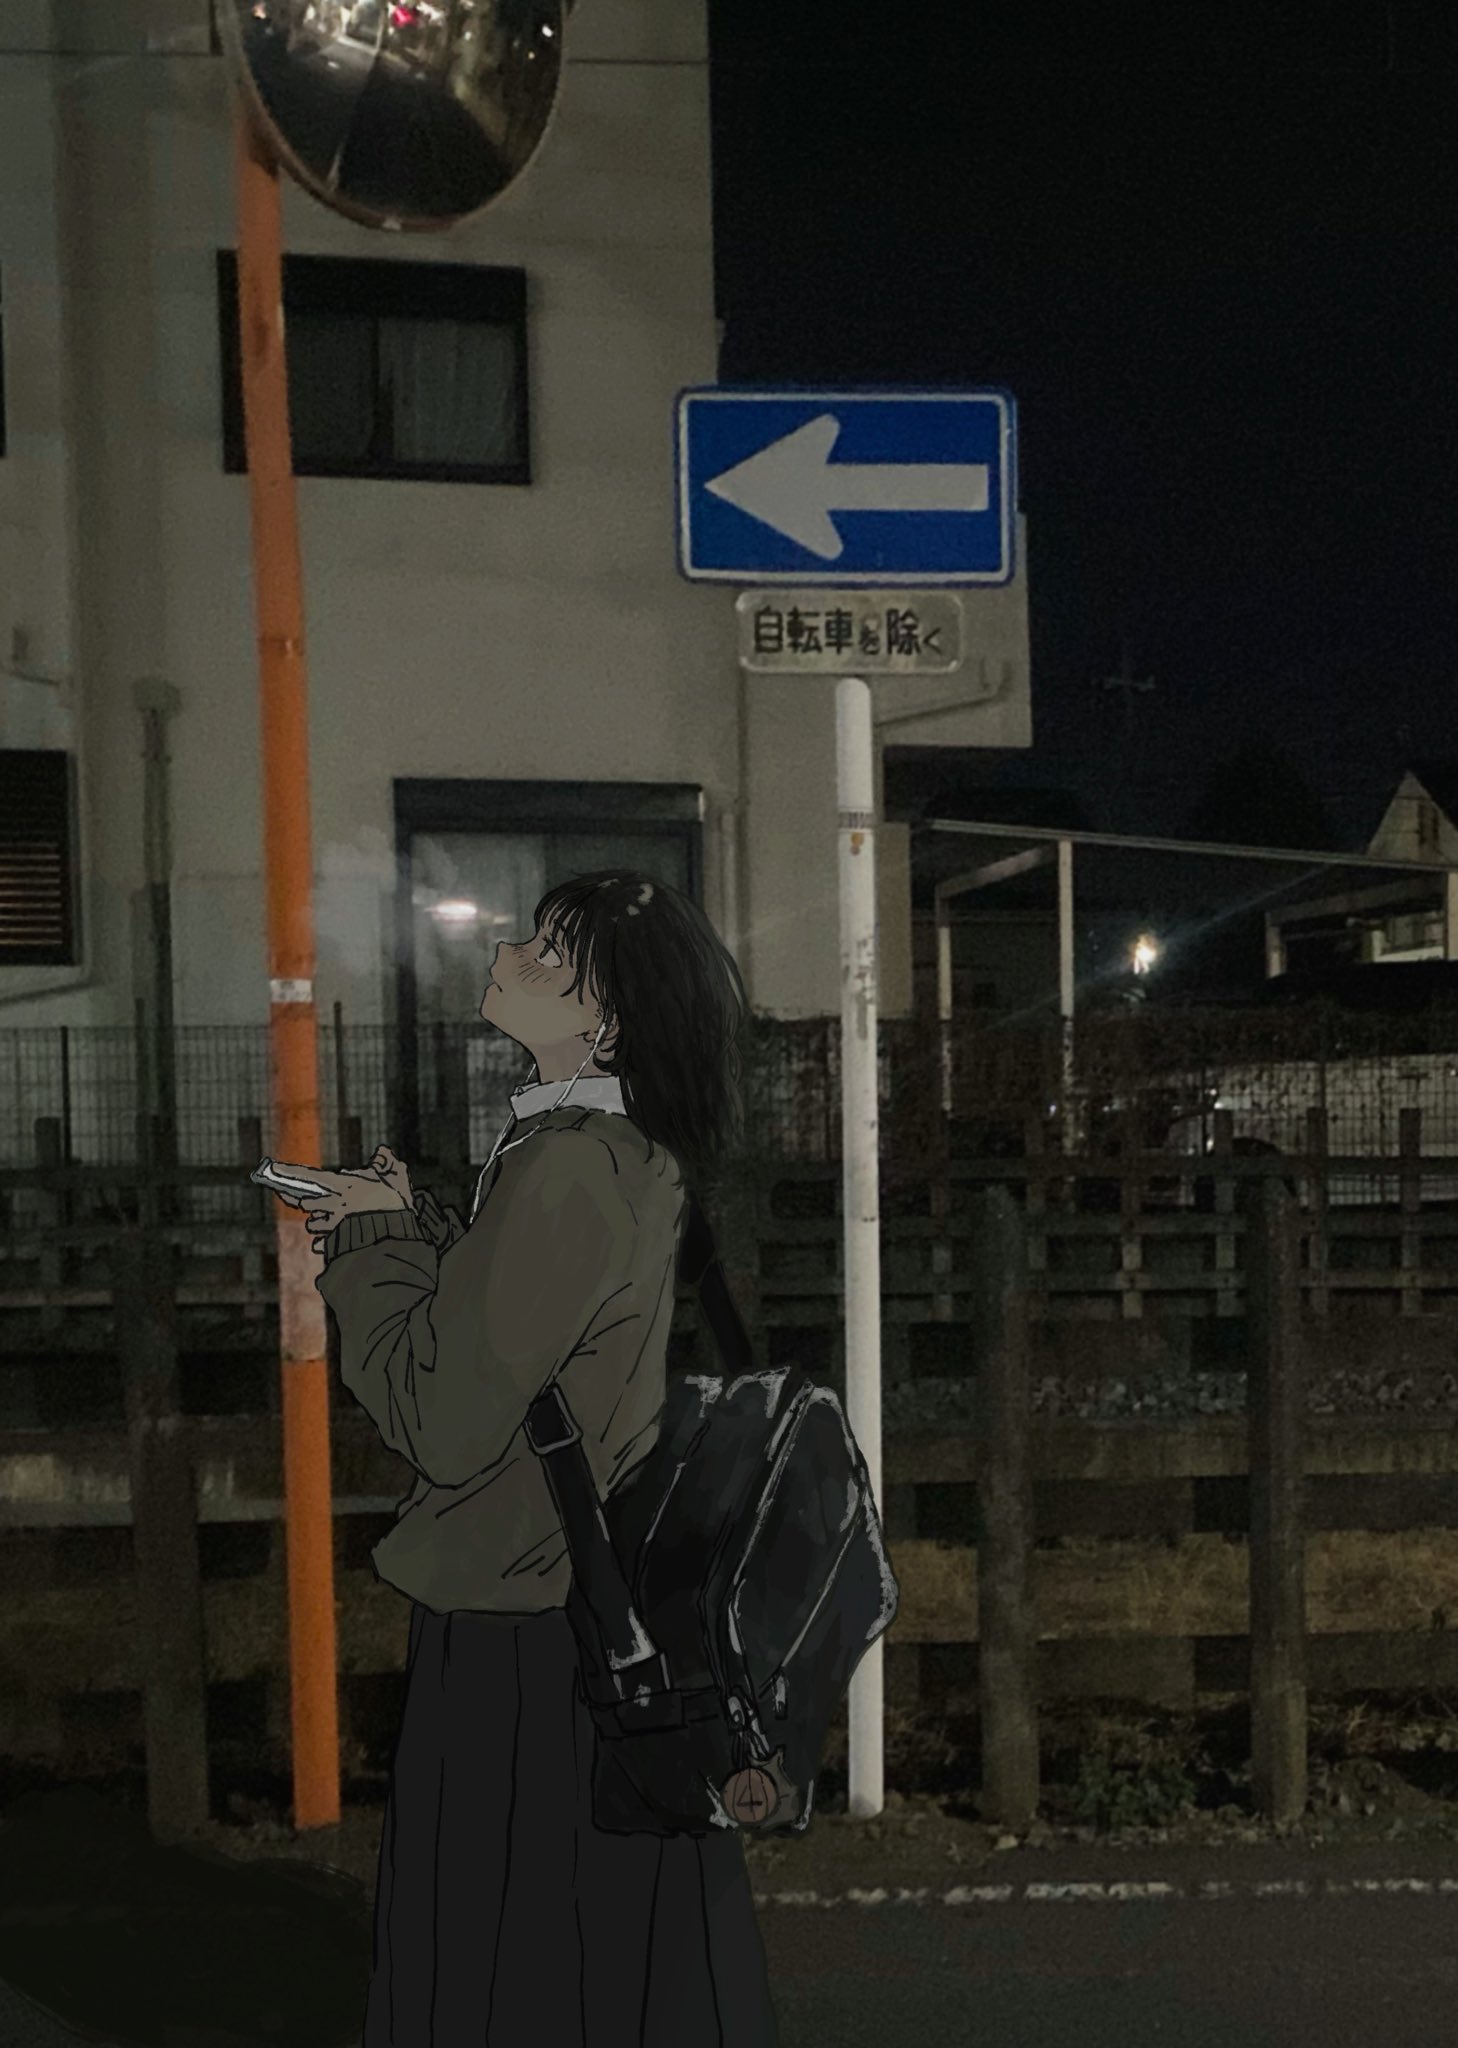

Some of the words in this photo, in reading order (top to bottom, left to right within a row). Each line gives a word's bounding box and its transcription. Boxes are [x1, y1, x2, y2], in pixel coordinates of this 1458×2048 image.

[755, 605, 942, 654] 自転車を除く
